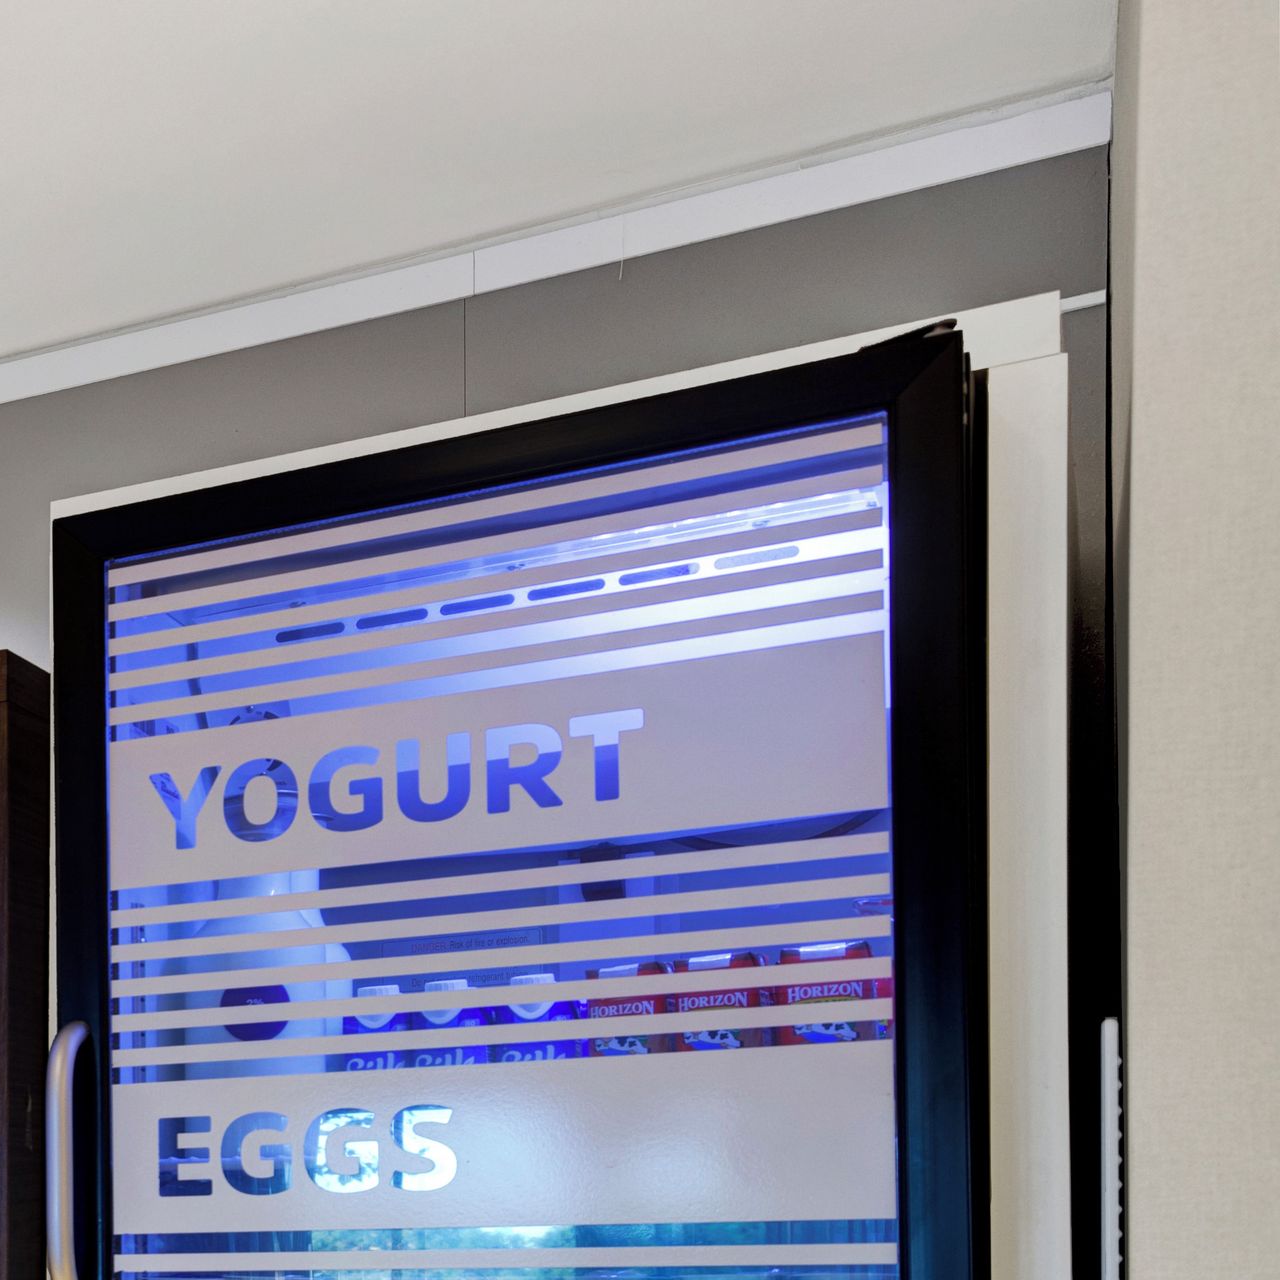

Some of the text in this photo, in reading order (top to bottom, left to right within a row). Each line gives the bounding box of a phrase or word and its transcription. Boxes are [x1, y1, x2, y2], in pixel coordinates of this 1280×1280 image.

[148, 707, 645, 850] YOGURT
[678, 992, 748, 1012] HORIZON
[787, 982, 863, 1004] HORIZON
[590, 1000, 655, 1018] HORIZON
[157, 1104, 458, 1198] EGGS
